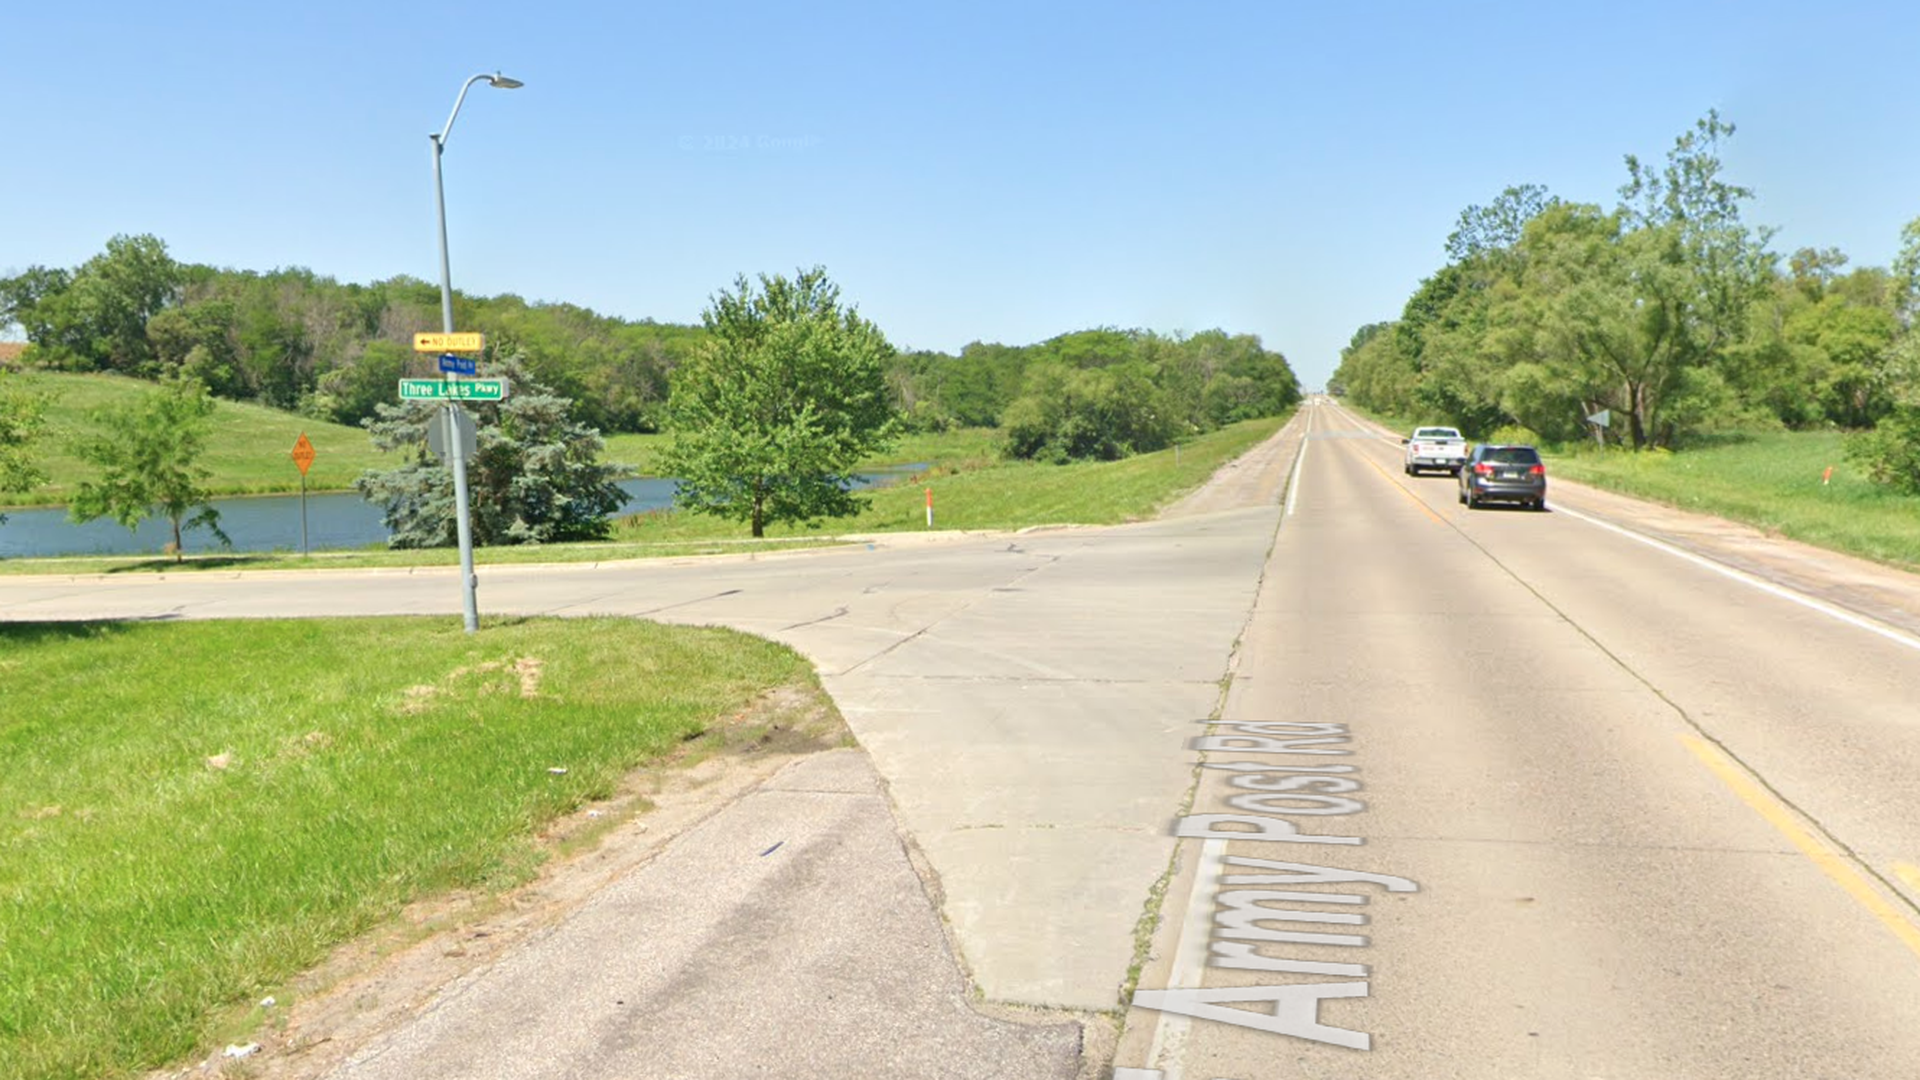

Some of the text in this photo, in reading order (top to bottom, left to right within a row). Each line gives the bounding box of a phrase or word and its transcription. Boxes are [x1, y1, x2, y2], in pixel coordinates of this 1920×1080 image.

[433, 337, 476, 346] NO OUTLET
[403, 382, 499, 396] Three Lakes Pkwy
